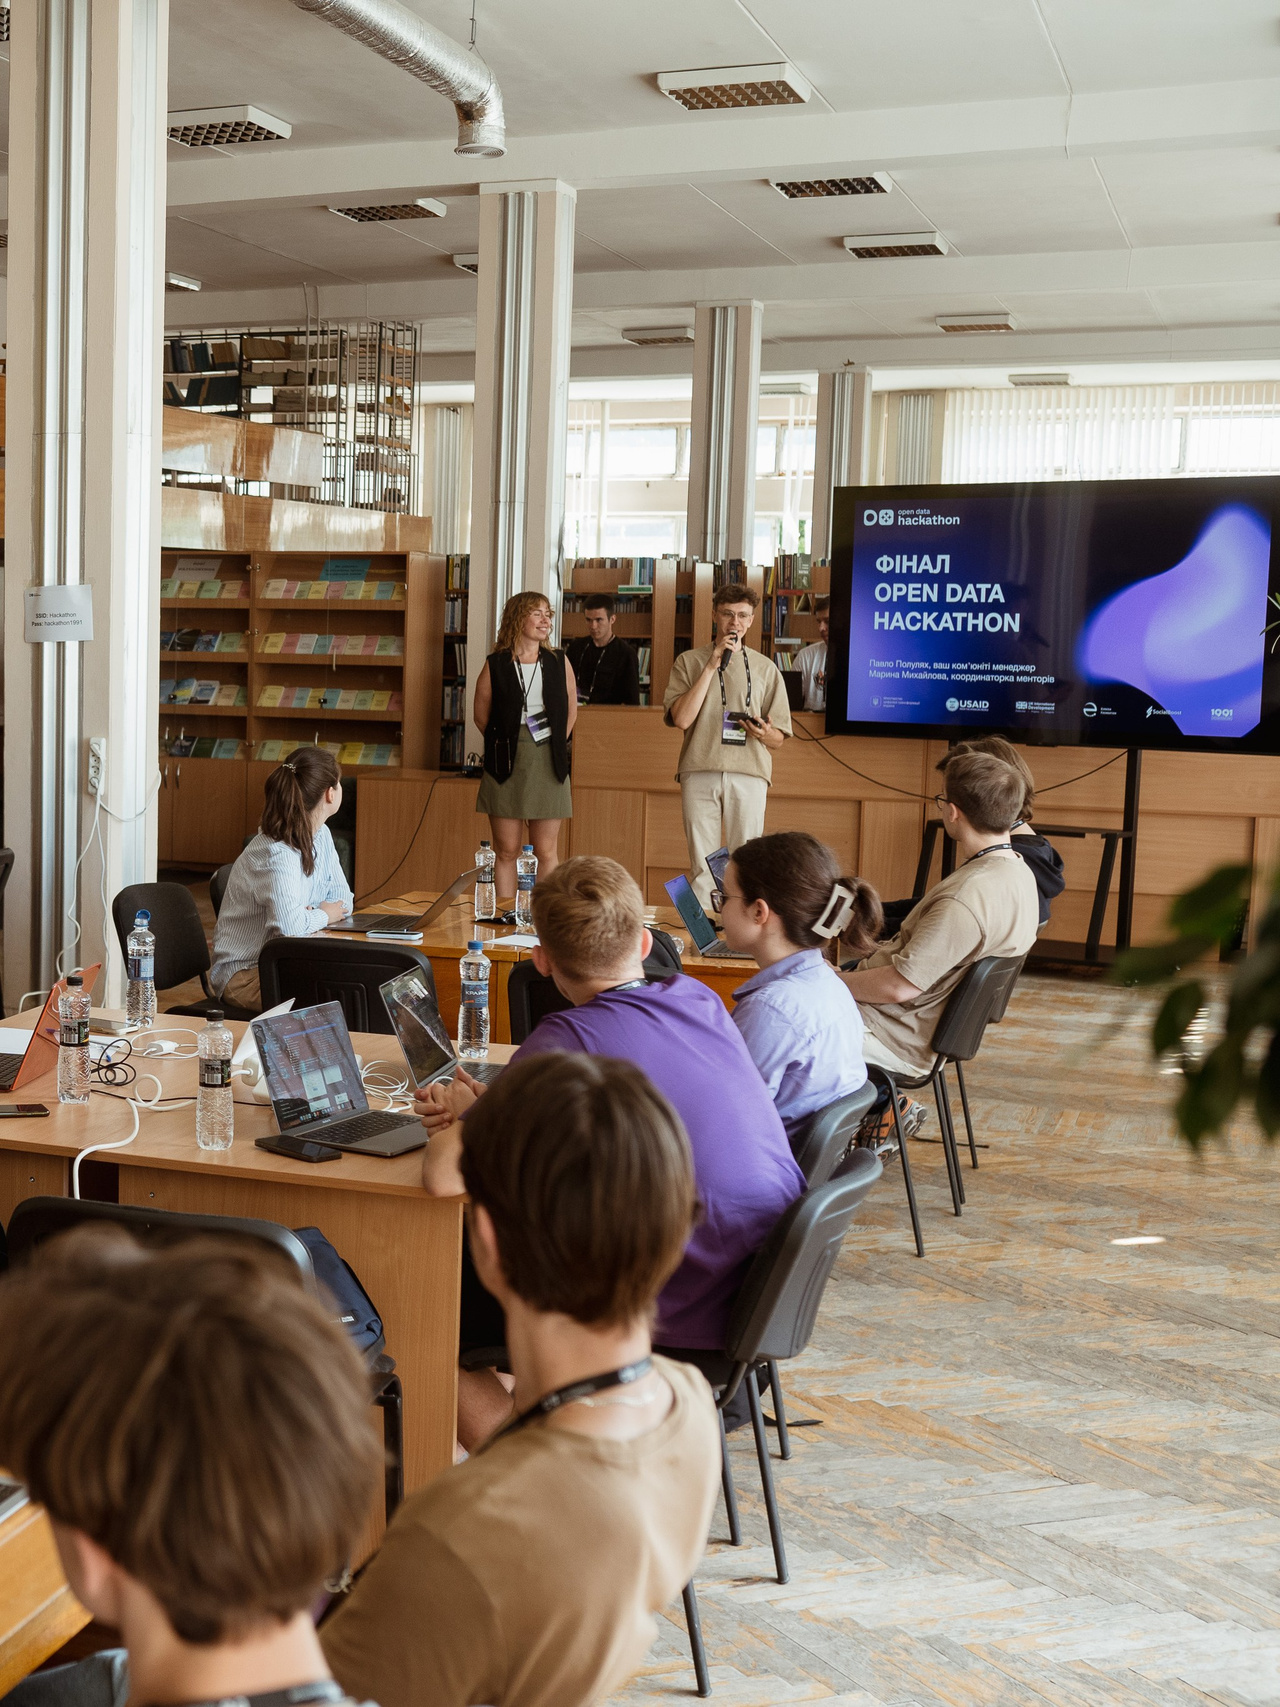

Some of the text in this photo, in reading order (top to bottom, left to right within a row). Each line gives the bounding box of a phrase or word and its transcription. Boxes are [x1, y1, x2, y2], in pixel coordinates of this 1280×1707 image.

[897, 515, 960, 526] hackathon
[875, 554, 951, 574] ФІНАЛ
[874, 582, 1006, 603] OPEN DATA
[873, 611, 1021, 633] HACKATHON
[869, 659, 894, 668] Павло
[933, 662, 950, 670] ваш
[992, 664, 1036, 673] менеджер
[868, 670, 1056, 685] Марина Михайлова, координаторка менторів
[959, 699, 989, 709] USAID
